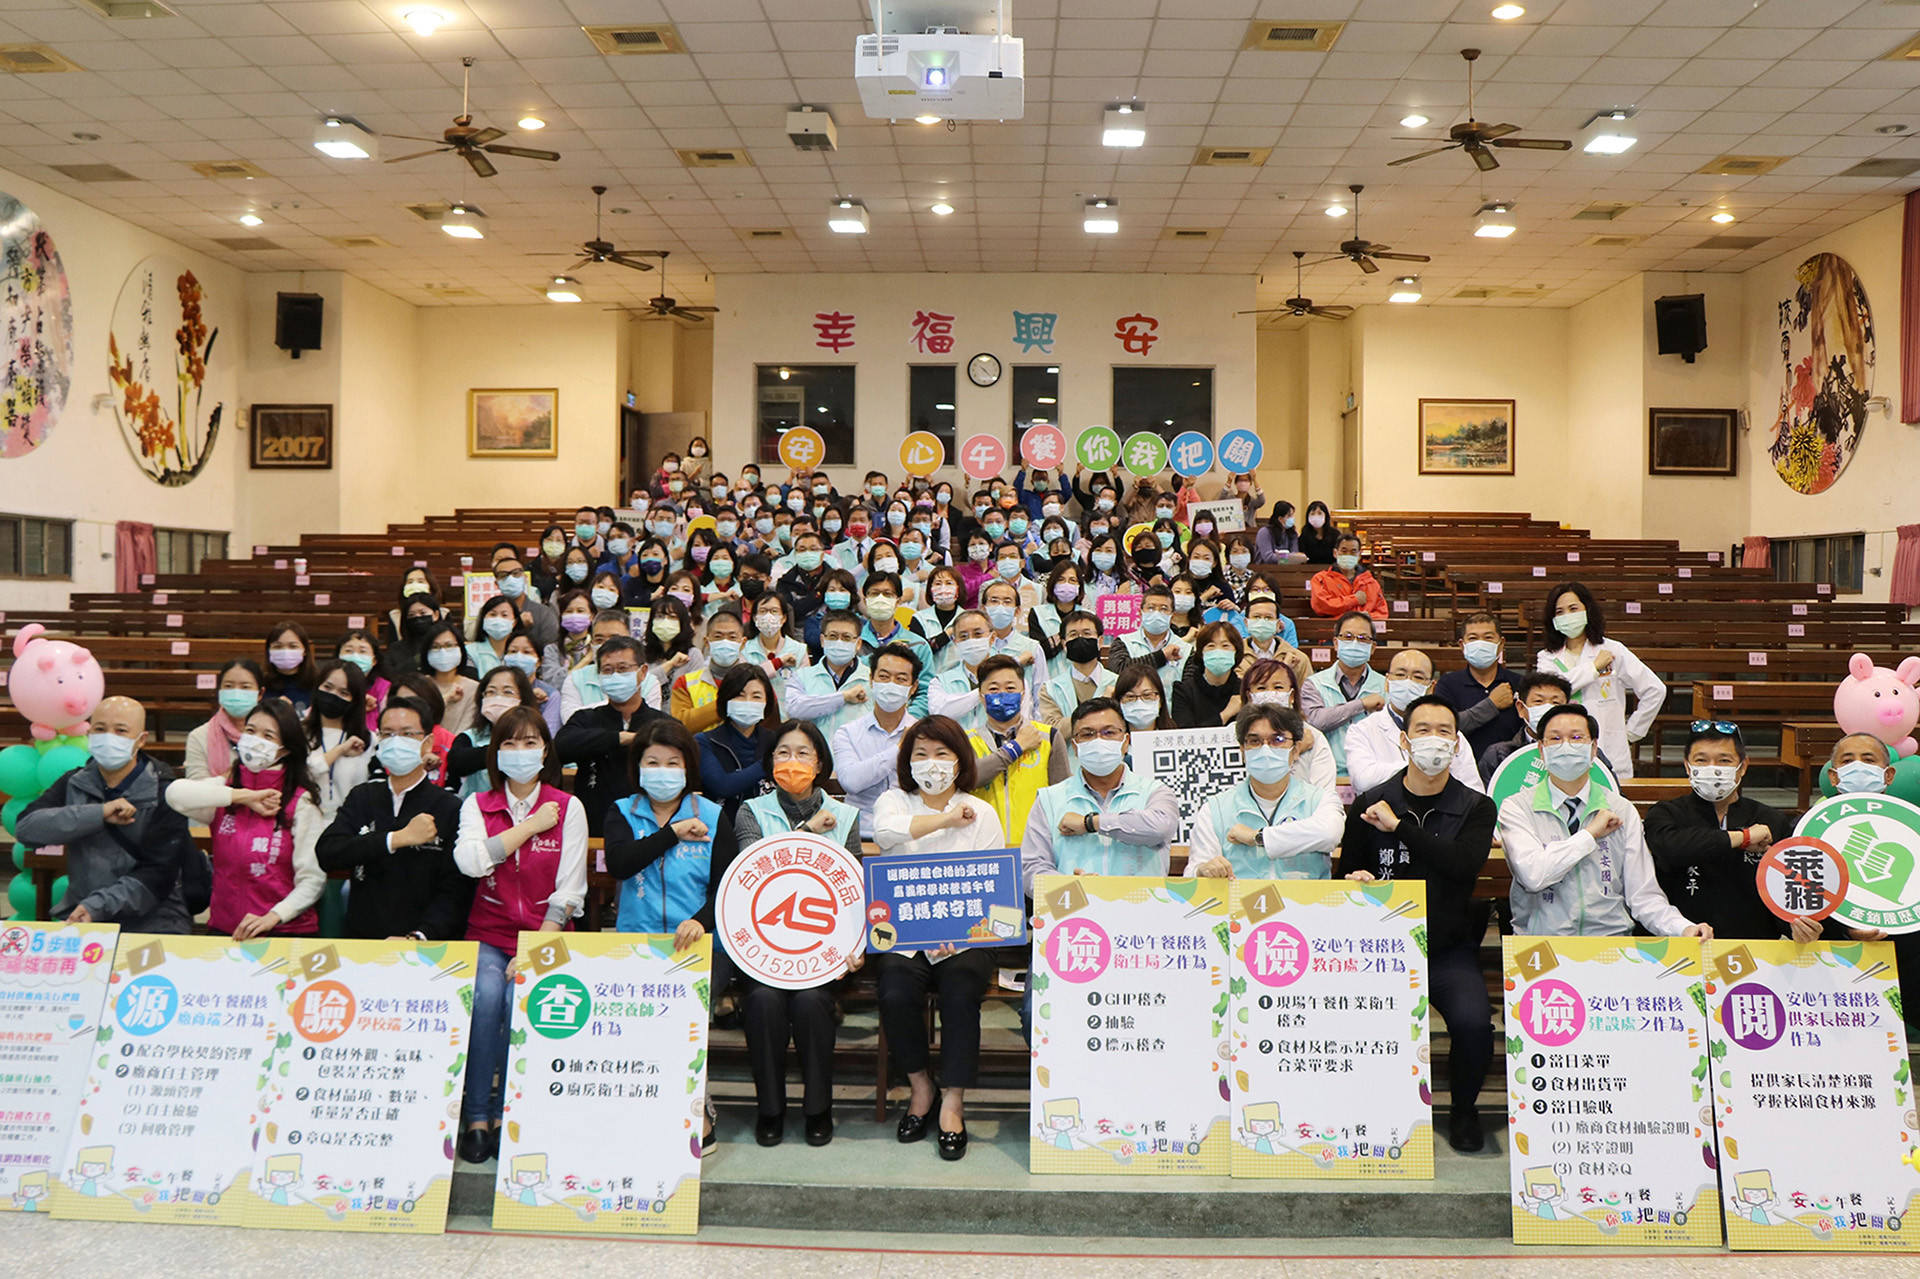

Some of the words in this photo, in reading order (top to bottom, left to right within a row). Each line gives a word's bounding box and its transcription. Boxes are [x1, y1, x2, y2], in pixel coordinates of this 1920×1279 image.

[813, 310, 1159, 356] 幸福興安
[263, 436, 324, 458] 2007
[1153, 732, 1238, 747] 臺灣農產生產追
[1815, 801, 1883, 824] TAP
[737, 847, 860, 908] 台灣優良農產品
[898, 898, 984, 922] 勇媽來守護
[1056, 926, 1102, 973] 檢
[1114, 935, 1207, 950] 安心午餐稽核
[1312, 938, 1406, 954] 安心午餐稽核
[731, 927, 842, 976] 第015202號
[1254, 930, 1301, 977] 檢
[1114, 954, 1207, 970] 衛生局之作為
[1312, 958, 1406, 974] 教育處之作為
[594, 983, 687, 999] 安心午餐稽核
[121, 984, 172, 1028] 源
[182, 993, 268, 1009] 安心午餐稽核
[360, 999, 449, 1014] 安心午餐稽核
[535, 984, 583, 1029] 查
[1276, 996, 1399, 1011] 現場午餐作業衛生
[1588, 996, 1684, 1012] 安心午餐稽核
[1786, 992, 1880, 1007] 安心午餐稽核
[301, 989, 350, 1034] 驗
[593, 1003, 670, 1018] 校營養師之
[1529, 988, 1577, 1036] 檢
[1731, 994, 1777, 1040] 閱
[357, 1017, 447, 1033] 學校端之作為
[1105, 1015, 1135, 1030] 抽驗
[1277, 1014, 1307, 1028] 稽查
[1588, 1016, 1685, 1032] 建設處之作為
[1789, 1012, 1882, 1028] 供家長檢視之
[591, 1021, 622, 1037] 作為
[1105, 1038, 1166, 1053] 標示稽查
[1790, 1031, 1821, 1047] 作為
[1277, 1040, 1399, 1055] 食材及標示是否符
[569, 1059, 660, 1075] 抽查食材標示
[1277, 1058, 1354, 1073] 合菜單要求
[1549, 1054, 1611, 1069] 當日菜單
[318, 1065, 406, 1080] 包裝是否完整
[1551, 1077, 1627, 1092] 食材出貨單
[1751, 1073, 1873, 1089] 提供家長清楚追蹤
[567, 1082, 658, 1099] 廚房衛生訪視
[1551, 1100, 1614, 1115] 當日驗收
[1752, 1094, 1876, 1109] 掌握校園食材來源
[310, 1105, 400, 1121] 重量是否正確
[1575, 1121, 1690, 1135] 廠商食材抽驗證明
[1577, 1141, 1634, 1155] 屠宰證明
